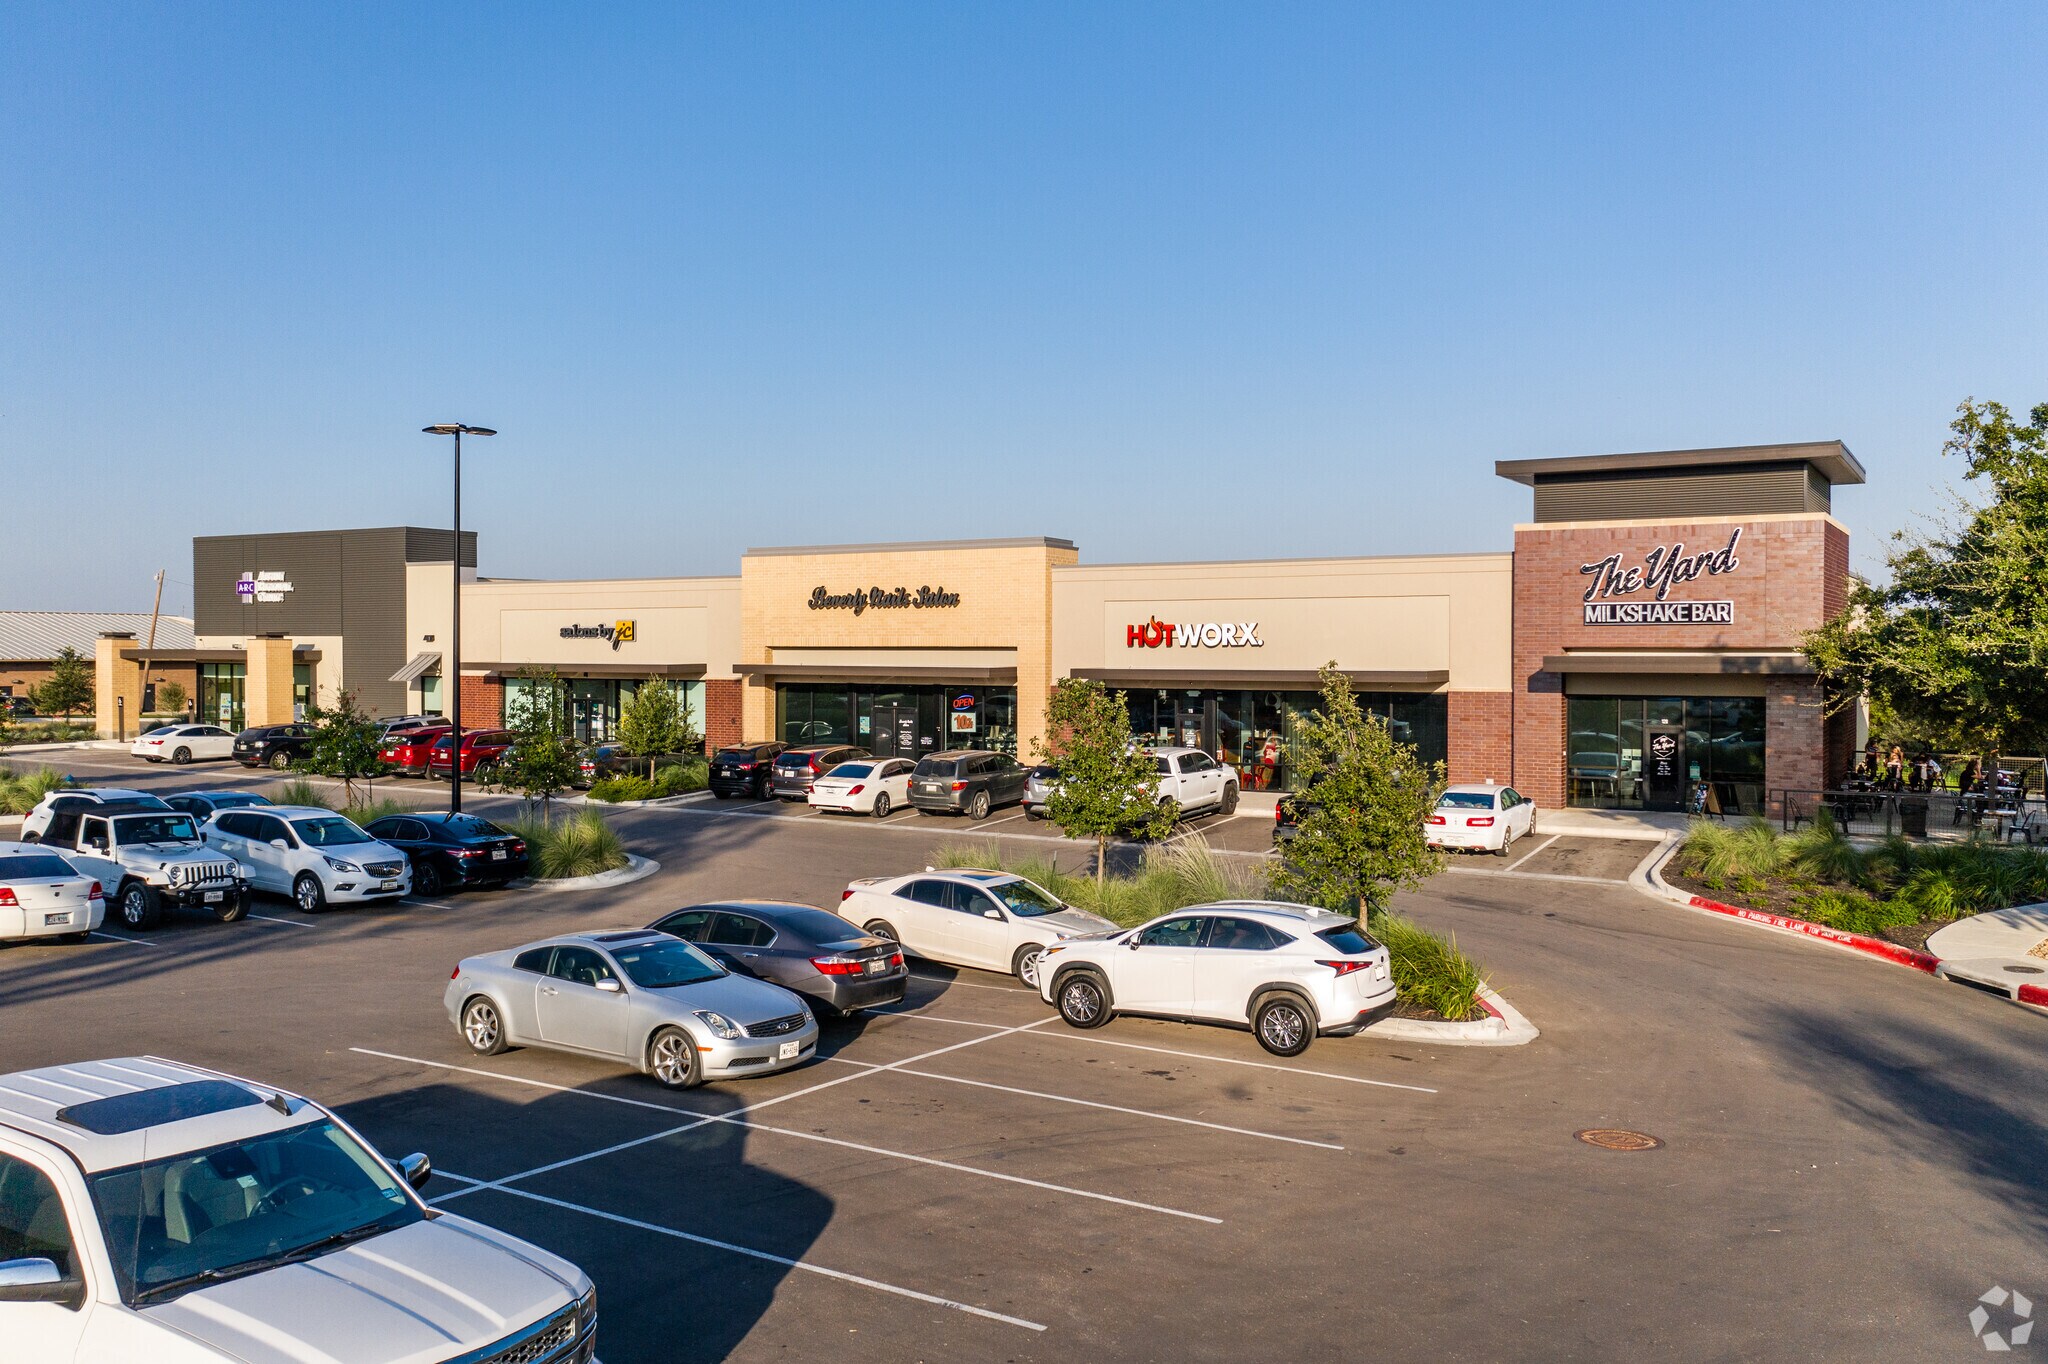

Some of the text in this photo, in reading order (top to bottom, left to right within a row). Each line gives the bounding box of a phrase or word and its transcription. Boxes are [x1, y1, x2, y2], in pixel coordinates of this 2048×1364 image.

[1580, 527, 1743, 601] The Yard
[808, 585, 961, 616] Beverly Nails Salon
[1585, 603, 1731, 623] MILKSHAKE BAR
[560, 624, 599, 638] salons
[598, 624, 615, 641] by
[953, 697, 975, 708] OPEN
[1748, 911, 1772, 924] PARKING
[1773, 918, 1787, 928] FIRE
[1789, 922, 1805, 932] LANE
[1808, 926, 1820, 935] TOW
